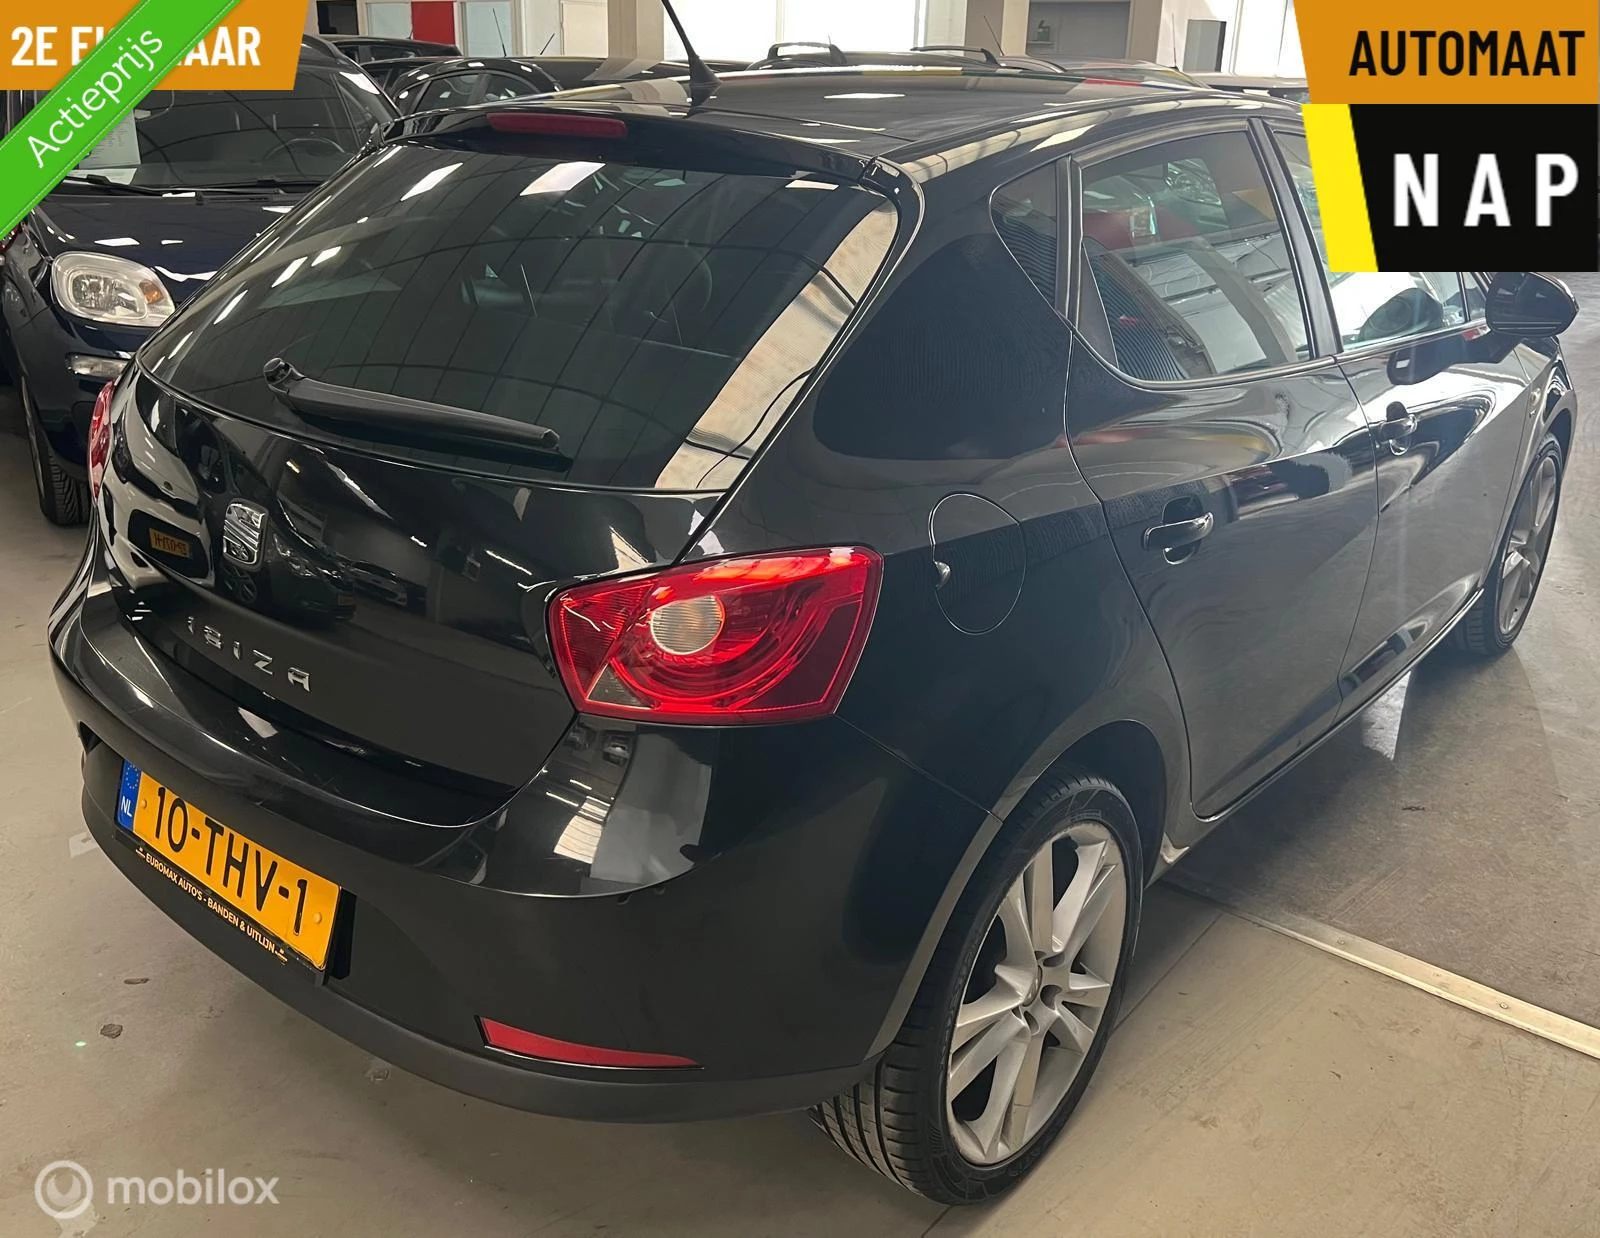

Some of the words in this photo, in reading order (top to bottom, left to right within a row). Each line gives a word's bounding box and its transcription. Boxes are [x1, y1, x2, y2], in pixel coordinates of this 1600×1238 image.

[120, 795, 133, 818] NL
[145, 852, 179, 884] EUROMAX
[178, 877, 203, 902] AUTO'S
[207, 897, 239, 929] BANDEN
[239, 919, 246, 932] &
[154, 786, 308, 937] 10-THV-1
